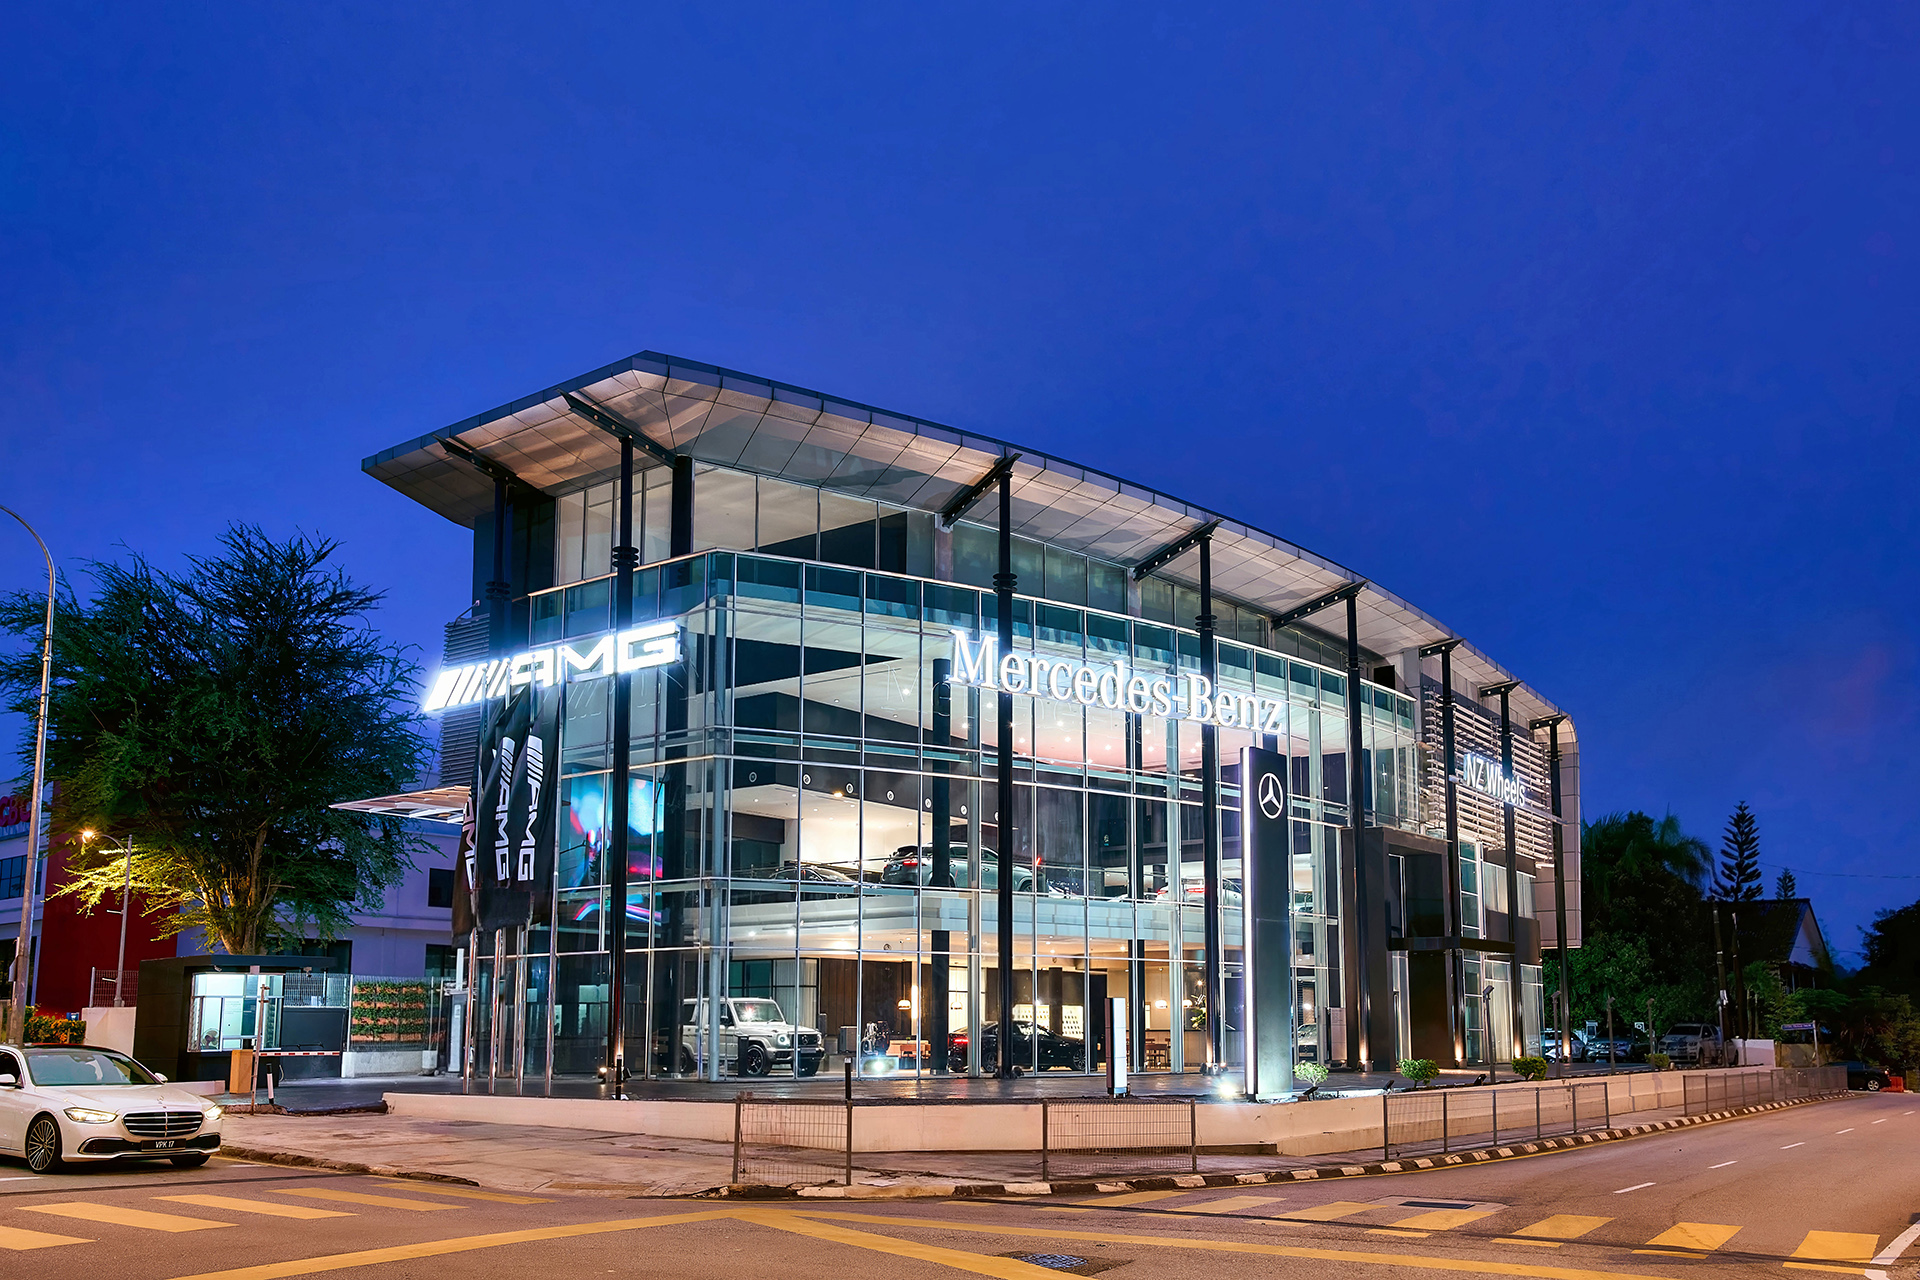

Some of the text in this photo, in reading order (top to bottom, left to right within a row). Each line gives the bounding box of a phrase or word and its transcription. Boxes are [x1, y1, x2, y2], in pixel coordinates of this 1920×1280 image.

[508, 621, 678, 687] AMG
[947, 629, 1283, 734] Mercedes-Benz
[1466, 753, 1525, 807] NZ Wheels
[517, 776, 541, 880] AMG
